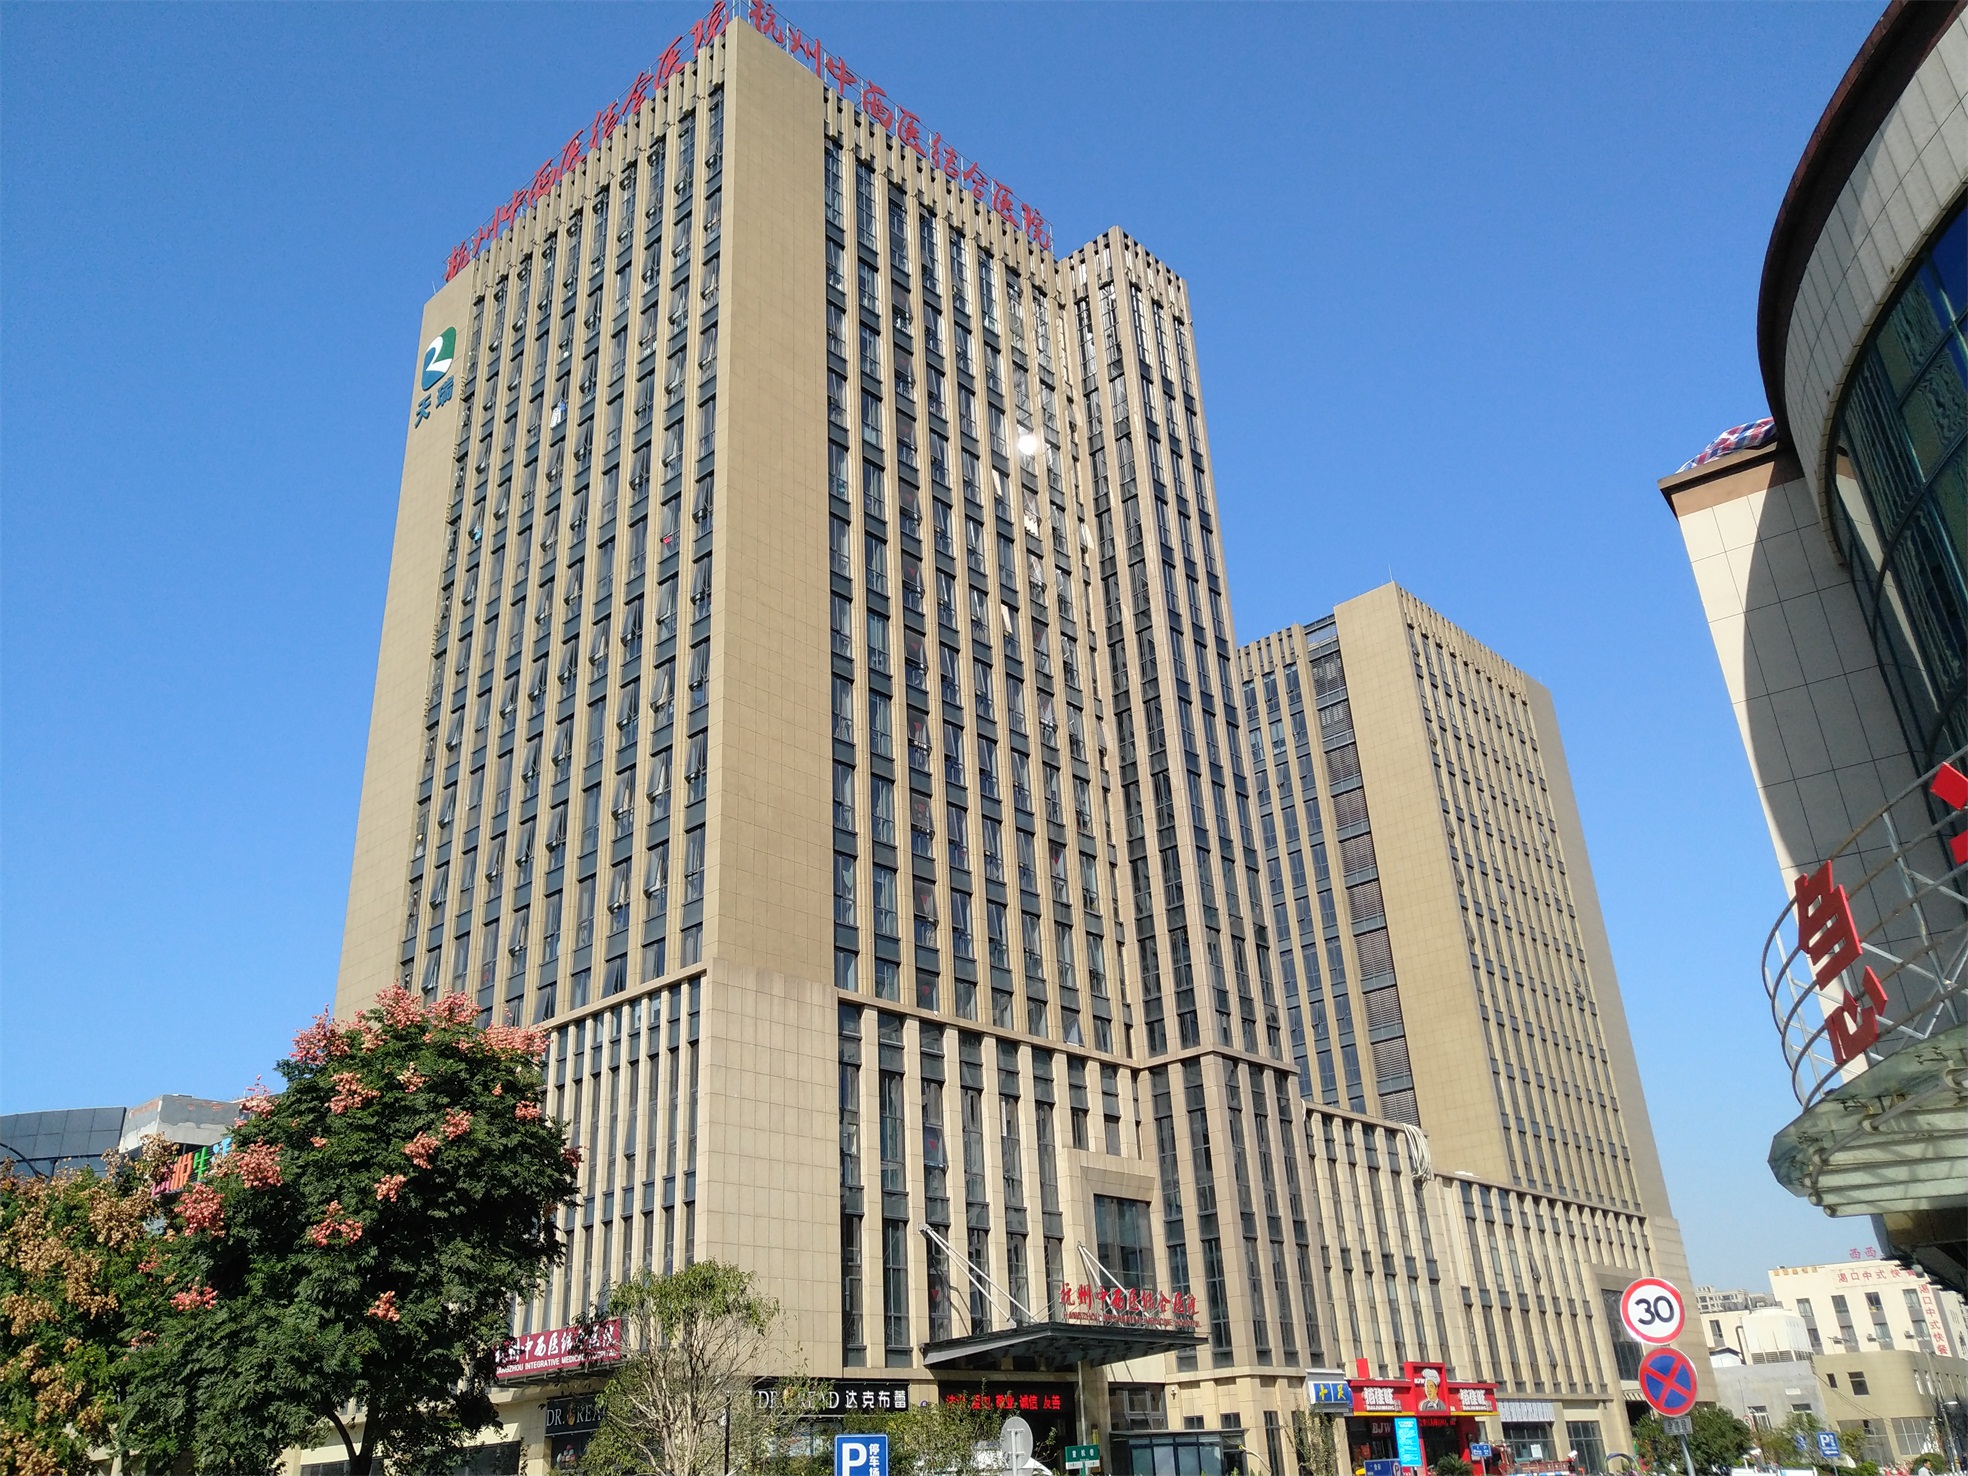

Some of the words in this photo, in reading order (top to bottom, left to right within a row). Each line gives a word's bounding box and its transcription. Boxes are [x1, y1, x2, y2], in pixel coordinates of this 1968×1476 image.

[748, 0, 1050, 251] 杭州中西医结合医院
[1060, 1282, 1200, 1316] 杭州中西医结合医院
[1634, 1295, 1675, 1325] 30
[524, 1358, 560, 1370] INTEGRATIVE
[845, 1389, 906, 1409] 达克布蕾
[1019, 1394, 1038, 1410] 诚信
[1820, 1434, 1829, 1447] P
[842, 1442, 867, 1476] P
